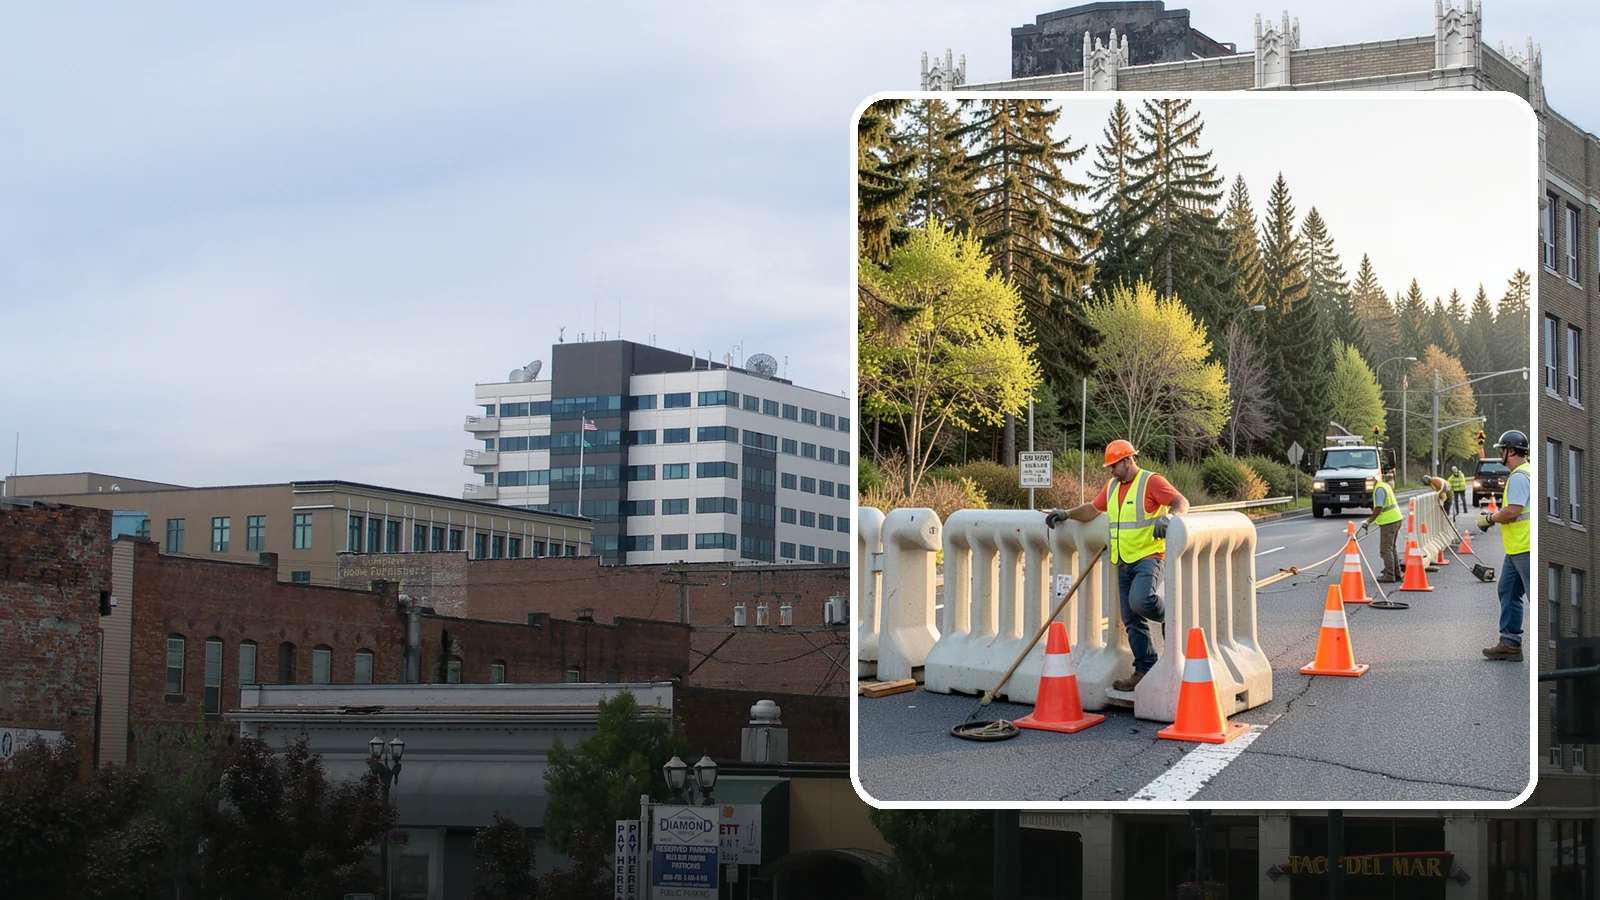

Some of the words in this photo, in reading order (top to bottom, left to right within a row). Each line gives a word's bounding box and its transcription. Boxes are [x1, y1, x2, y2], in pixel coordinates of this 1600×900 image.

[370, 566, 427, 576] Furnishers
[660, 818, 713, 832] DIAMOND
[1022, 815, 1069, 828] BUILDING
[617, 825, 625, 852] PAY
[628, 824, 637, 852] PAY
[656, 845, 688, 853] RESERVED
[689, 846, 716, 854] PARKING
[721, 852, 739, 862] Soup
[671, 862, 701, 870] PATRONS
[1289, 855, 1329, 874] TAC
[1346, 856, 1385, 876] DEL
[1392, 857, 1442, 877] MAR
[616, 856, 625, 893] HERE
[627, 855, 636, 893] HERE
[660, 888, 682, 897] PUBLIC
[683, 889, 710, 898] PARKING
